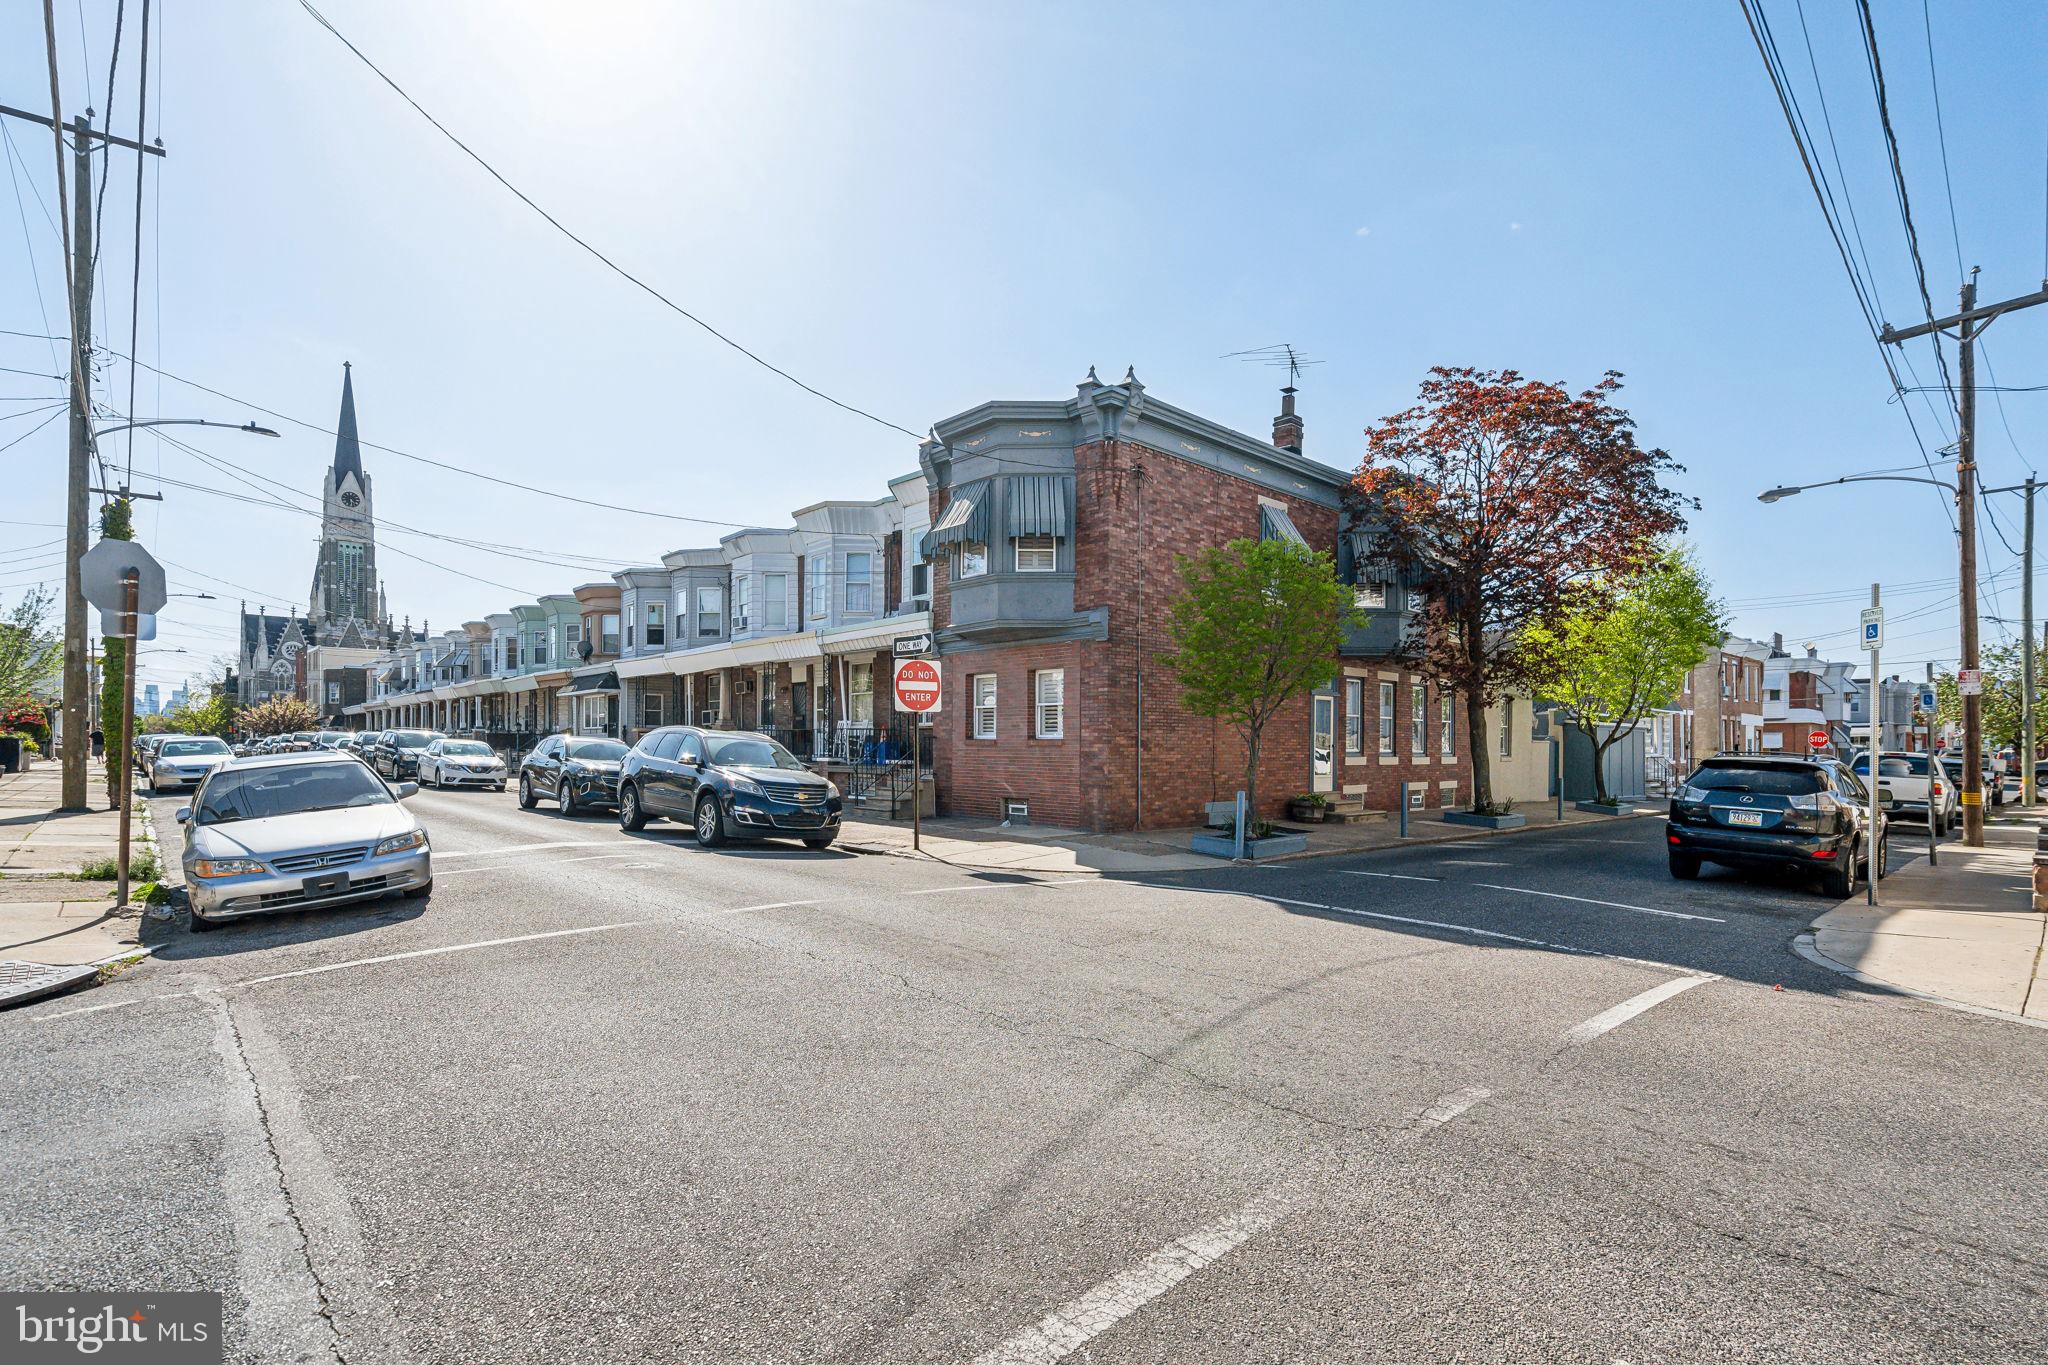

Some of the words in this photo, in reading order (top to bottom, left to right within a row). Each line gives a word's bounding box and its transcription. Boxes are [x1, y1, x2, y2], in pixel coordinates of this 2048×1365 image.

[898, 641, 911, 651] ONE
[912, 640, 923, 650] WAY
[902, 670, 914, 679] DO
[918, 671, 934, 680] NOT
[905, 692, 931, 702] ENTER
